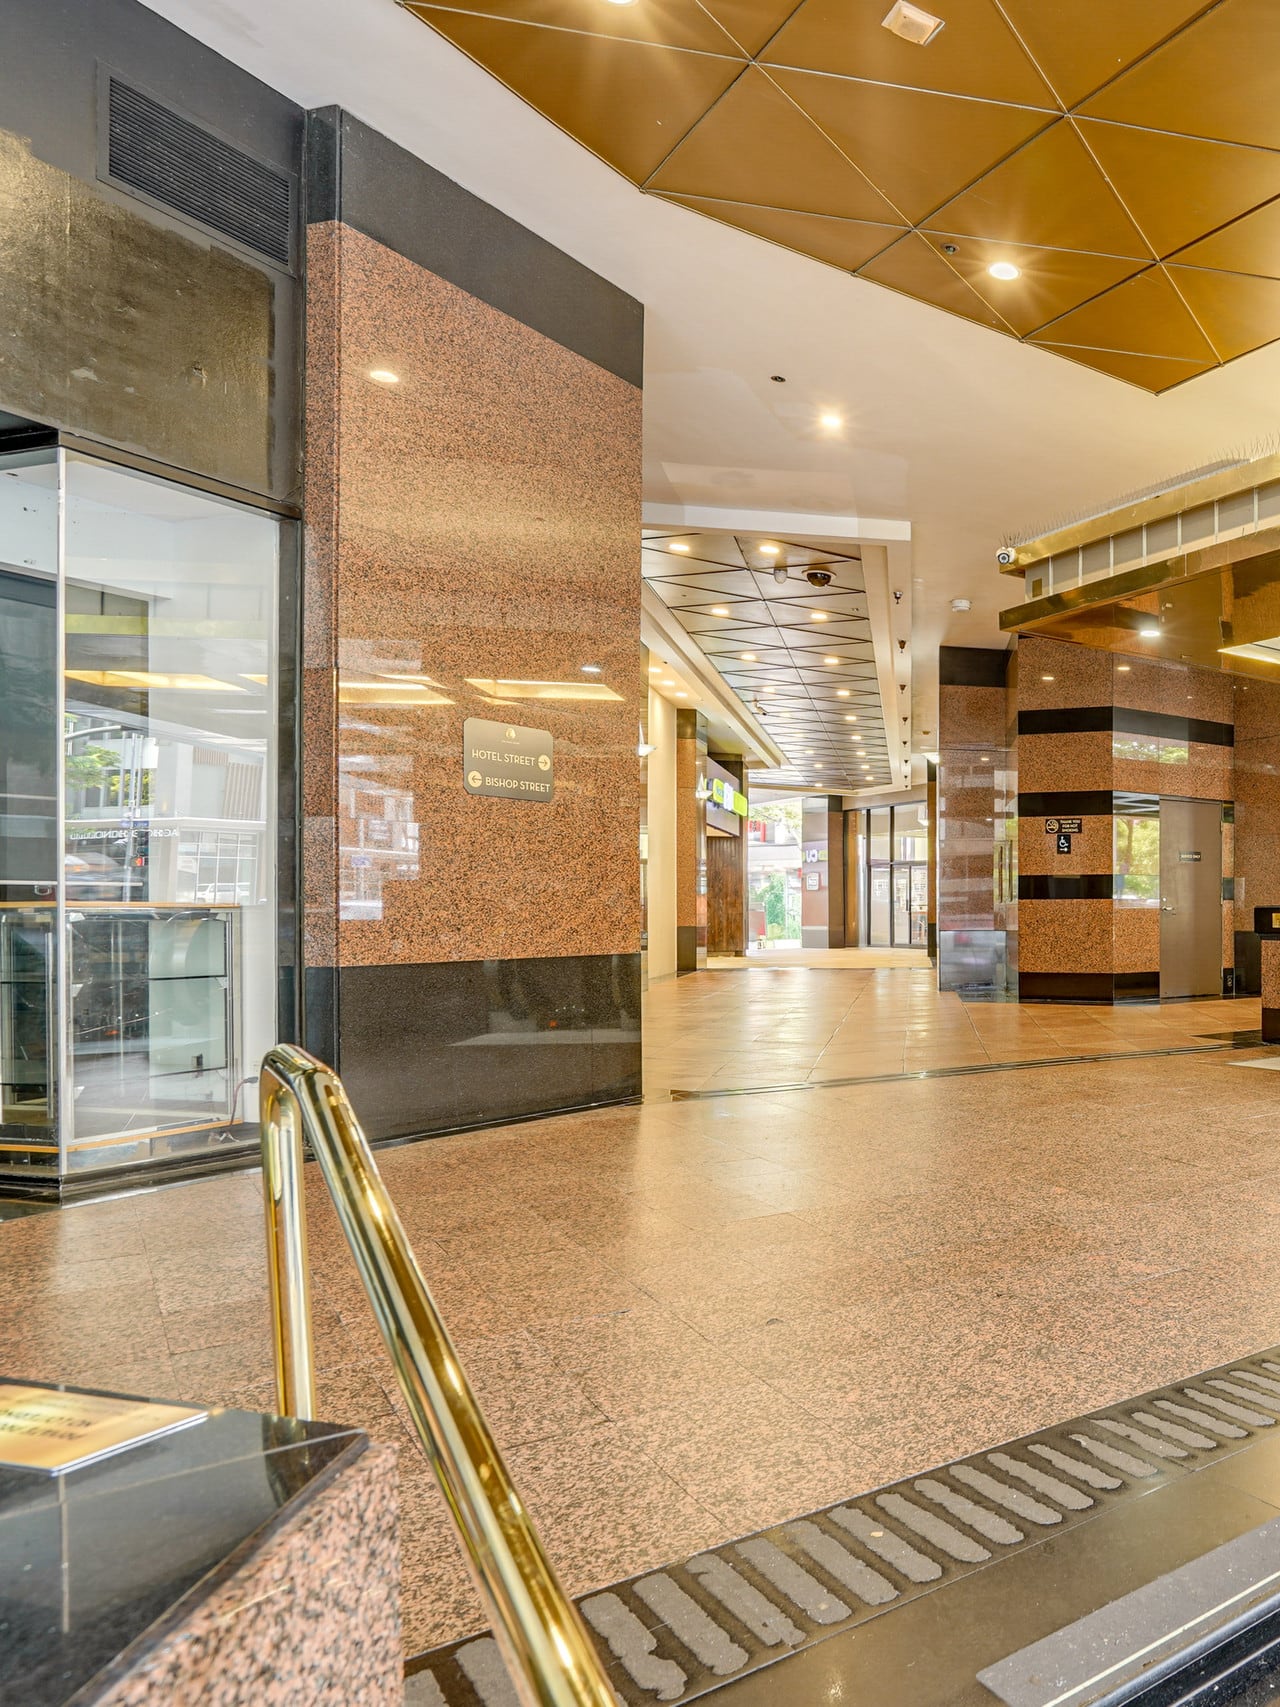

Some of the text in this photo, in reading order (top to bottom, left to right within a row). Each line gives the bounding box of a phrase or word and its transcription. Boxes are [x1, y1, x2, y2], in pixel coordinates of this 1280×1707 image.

[471, 748, 535, 767] HOTEL STREET
[485, 776, 550, 793] BISHOP STREET
